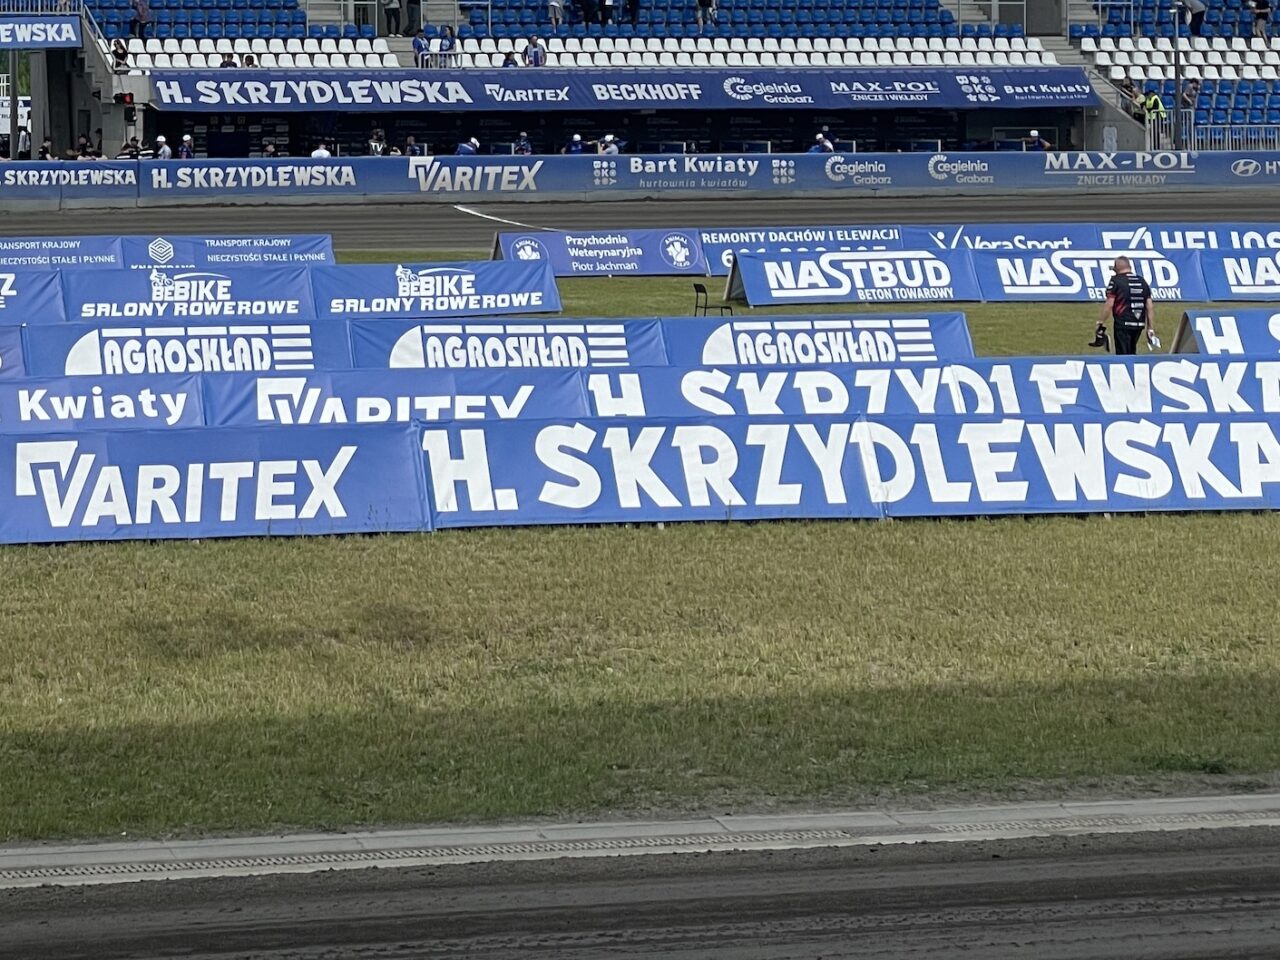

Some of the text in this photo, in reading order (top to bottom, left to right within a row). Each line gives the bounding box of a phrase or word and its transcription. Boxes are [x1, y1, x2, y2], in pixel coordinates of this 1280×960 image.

[156, 79, 473, 105] H. SKRZYDLEWSKA
[487, 87, 570, 102] VARITEX
[592, 83, 702, 101] BECKHOFF
[1003, 84, 1090, 94] Bart Kwiaty
[763, 94, 815, 104] Grabarz
[851, 93, 883, 102] ZNICZE
[630, 156, 760, 176] Bart Kwiaty
[835, 161, 886, 176] cegielnia
[937, 160, 989, 174] cegielnia
[4, 169, 137, 186] SKRZYDLEWSKA
[152, 165, 357, 188] H. SKRZYDLEWSKA
[415, 160, 544, 192] VARITEX
[639, 178, 696, 188] hurtownia
[853, 175, 892, 186] Grabarz
[955, 174, 995, 185] Grabarz
[1077, 176, 1115, 186] ZNICZE
[1122, 174, 1168, 185] WKŁADY
[205, 238, 292, 248] TRANSPORT KRAJOWY
[566, 235, 628, 247] Przychodnia
[702, 232, 766, 244] REMONTY
[770, 229, 826, 243] DACHÓW
[837, 229, 900, 242] ELEWACJI
[42, 240, 81, 250] KRAJOWY
[568, 246, 644, 259] Weterynaryjna
[52, 254, 77, 264] STAŁE
[84, 253, 117, 264] PŁYNNE
[207, 251, 262, 263] NIECZYSTOŚCI
[264, 252, 288, 262] STAŁE
[295, 251, 327, 262] PŁYNNE
[572, 259, 638, 272] Piotr Jachman
[764, 250, 952, 298] NASTBUD
[857, 287, 954, 301] BETON TOWAROWY
[173, 299, 299, 316] ROWEROWE
[419, 292, 543, 312] ROWEROWE
[425, 336, 588, 369] AGROSKŁAD
[736, 331, 897, 365] AGROSKŁAD
[103, 337, 272, 375] AGROSKŁAD
[18, 386, 188, 427] Kwiaty
[422, 417, 1280, 513] H. SKRZYDLEWSKA
[37, 444, 358, 528] VARITEX
